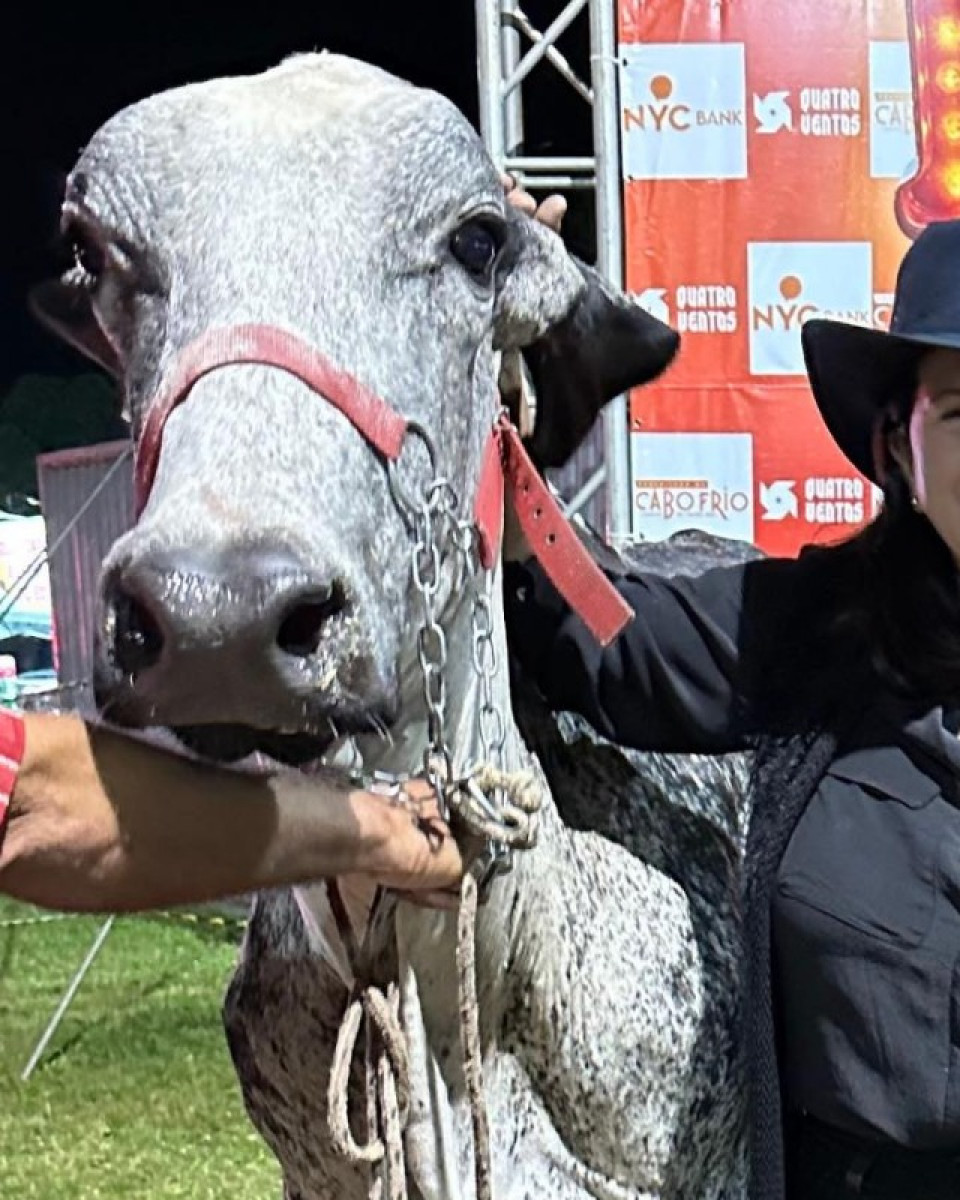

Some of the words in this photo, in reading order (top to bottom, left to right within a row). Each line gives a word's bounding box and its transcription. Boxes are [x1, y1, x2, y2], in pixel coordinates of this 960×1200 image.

[623, 104, 691, 132] NYC
[696, 110, 743, 127] BANK
[635, 489, 694, 519] CABO
